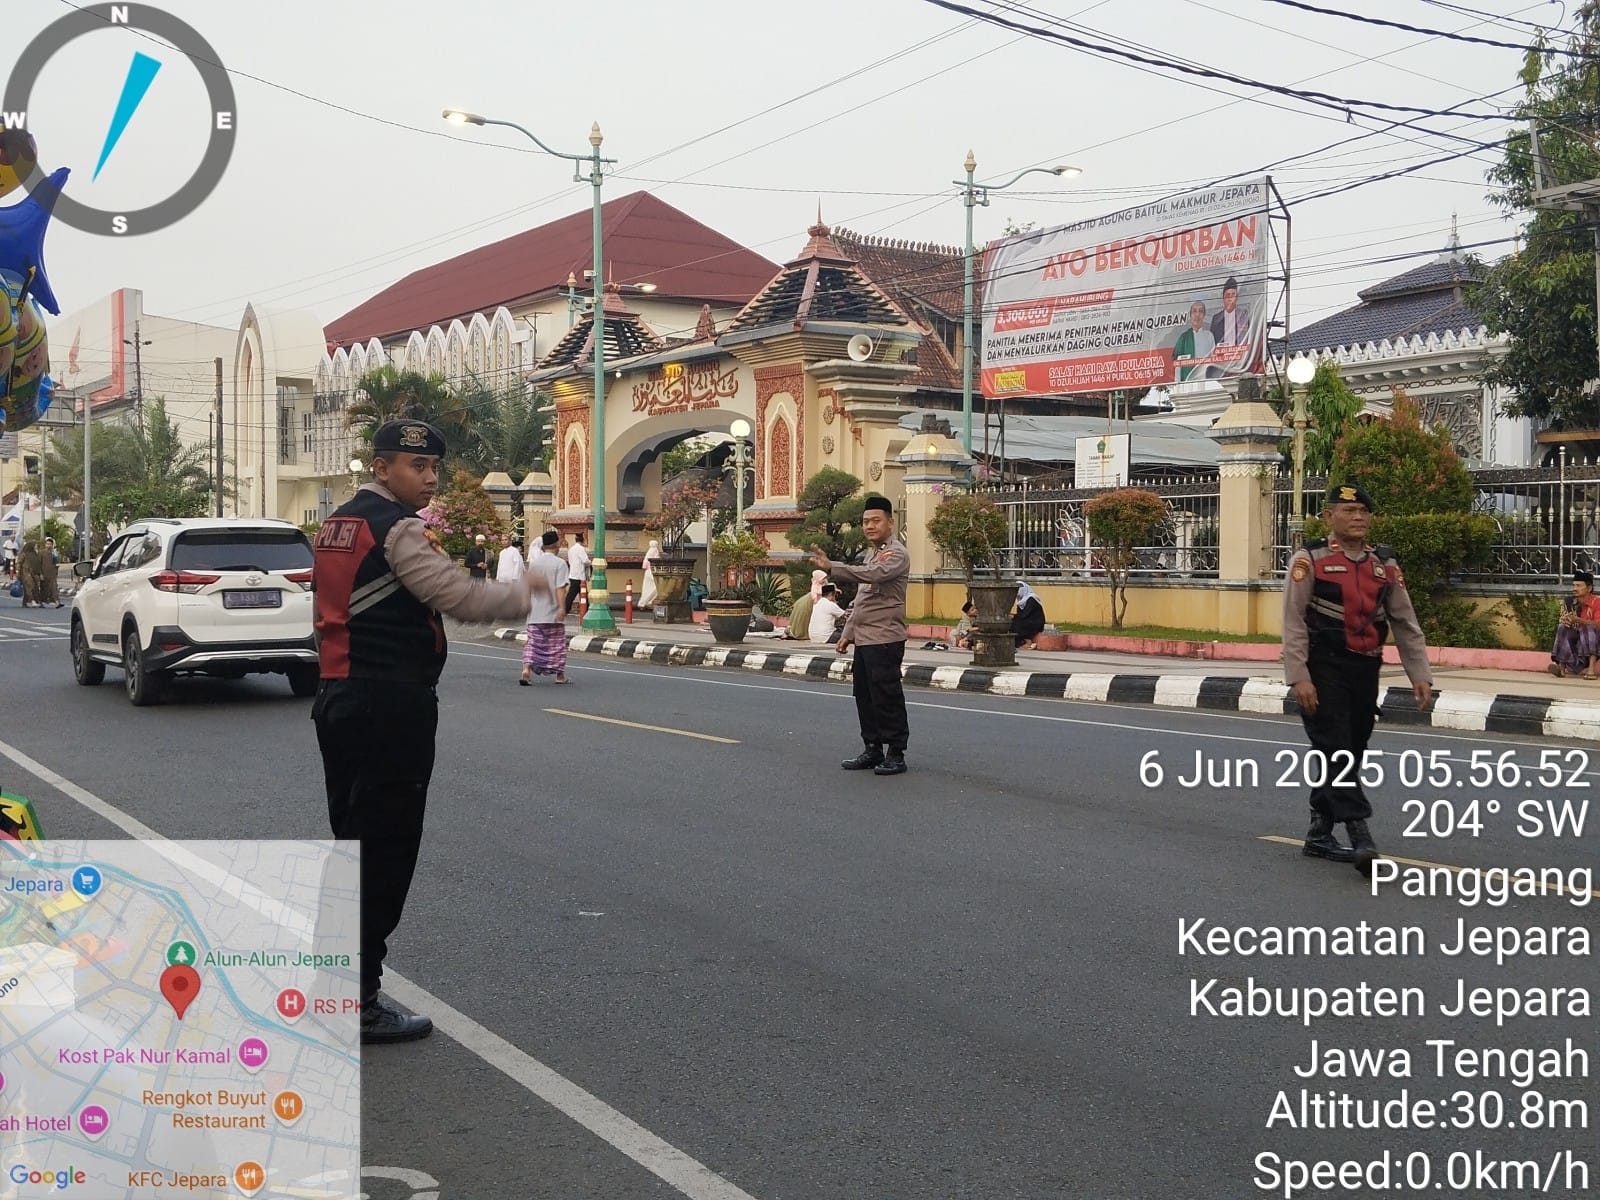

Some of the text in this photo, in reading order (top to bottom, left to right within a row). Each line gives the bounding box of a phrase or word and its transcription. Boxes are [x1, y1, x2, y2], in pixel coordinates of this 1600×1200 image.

[1098, 210, 1132, 227] AGUNG
[1134, 202, 1168, 219] BAITUL
[1171, 193, 1216, 211] MAKMUR
[1219, 185, 1260, 201] JEPARA
[1042, 216, 1256, 281] AYO BERQURBAN
[1175, 256, 1220, 272] IDULADHA
[1223, 251, 1246, 264] 1446
[987, 313, 1187, 349] PANITIA MENERIMA PENITIPAN HEWAN QURBAN
[987, 332, 1143, 361] DAN MENYALURKAN DAGING QURBAN
[1049, 365, 1074, 379] SALAT
[1075, 363, 1096, 377] HARI
[1097, 361, 1118, 375] RAYA
[1119, 356, 1165, 372] IDULADHA
[317, 521, 357, 548] POLISI
